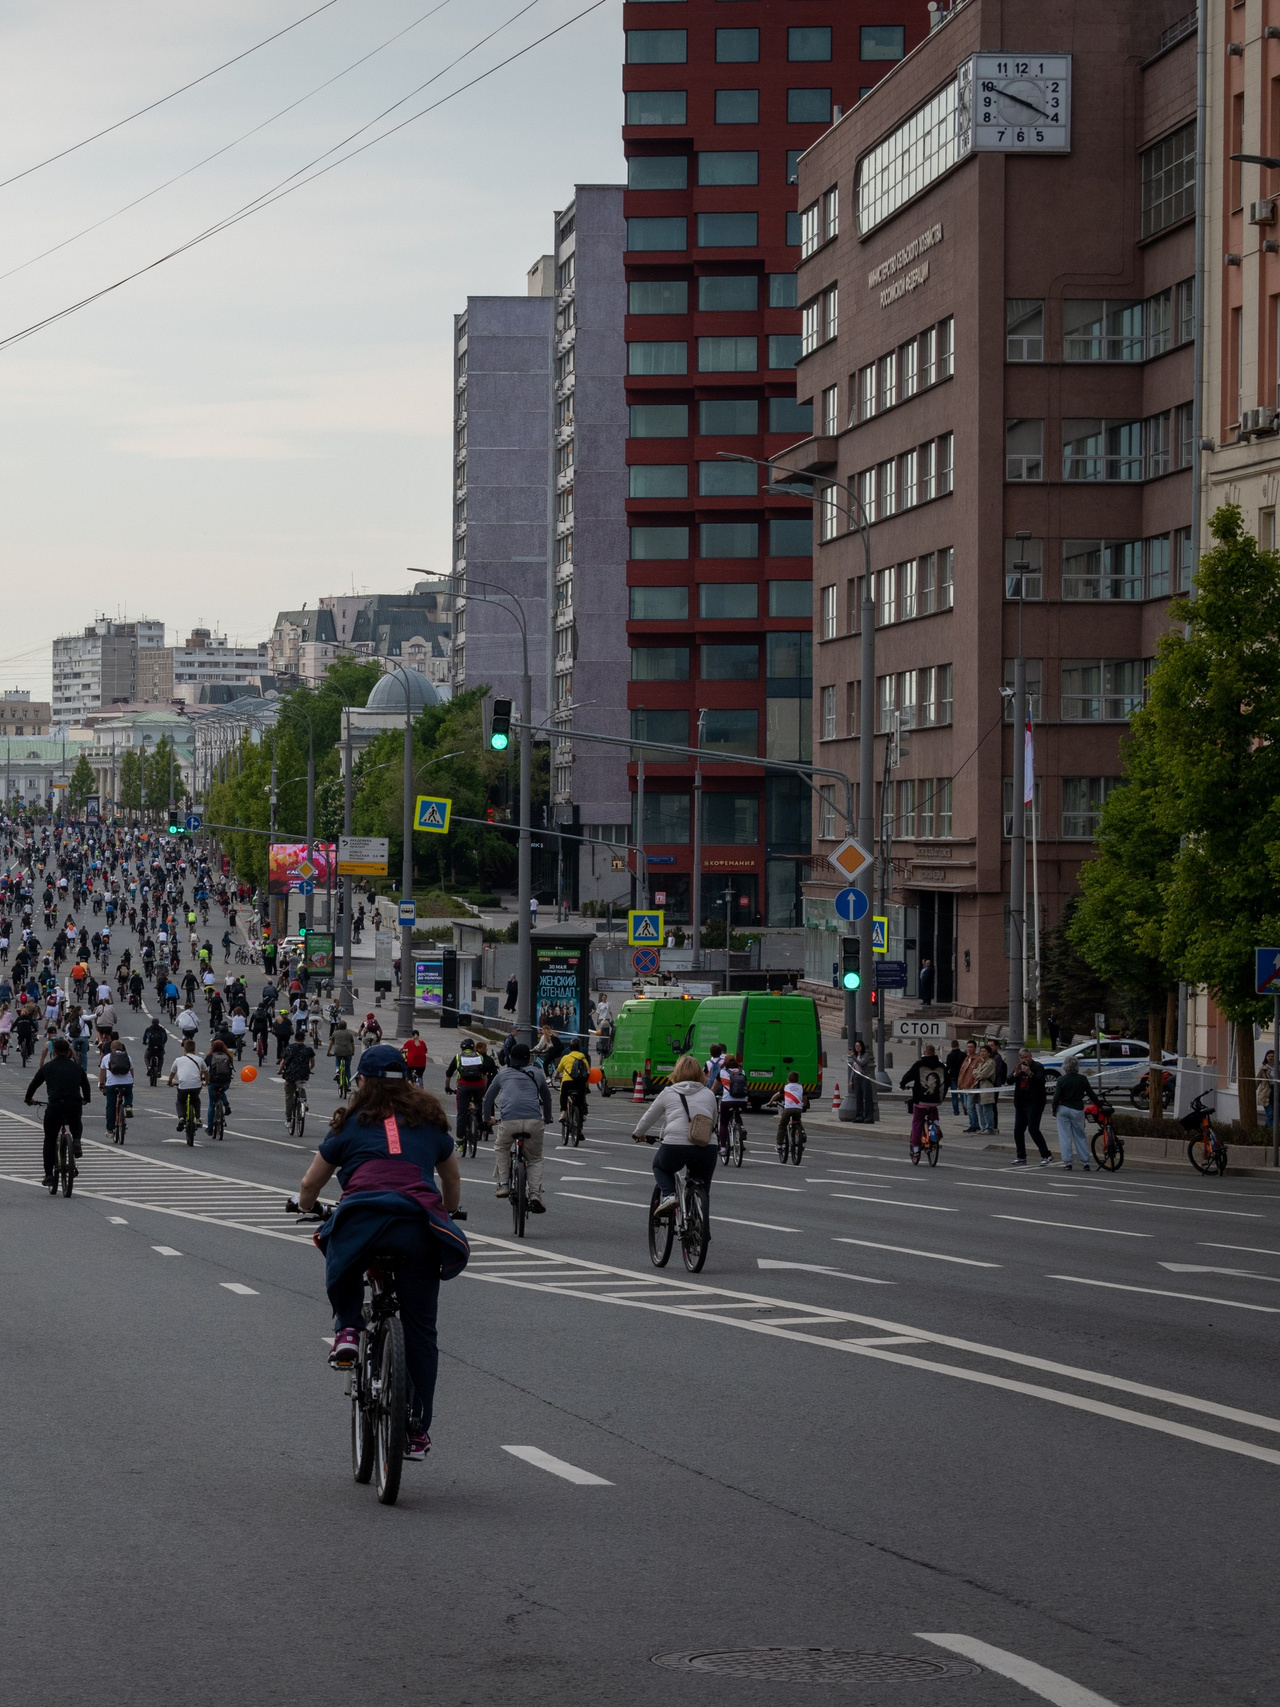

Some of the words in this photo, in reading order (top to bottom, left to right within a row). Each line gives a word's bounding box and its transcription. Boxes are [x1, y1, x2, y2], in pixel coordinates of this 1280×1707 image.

[997, 63, 1007, 73] 11
[1015, 63, 1028, 74] 12
[1039, 63, 1044, 74] 1
[981, 81, 993, 93] 10
[1051, 82, 1059, 93] 2
[983, 97, 991, 107] 9
[1051, 98, 1060, 108] 3
[983, 112, 991, 123] 8
[1051, 113, 1060, 123] 4
[997, 131, 1005, 142] 7
[1017, 131, 1025, 142] 6
[1036, 131, 1044, 142] 5
[539, 974, 576, 986] ЖЕНСКИЙ
[541, 987, 575, 998] СТЕНДАП
[900, 1022, 939, 1035] СТОП
